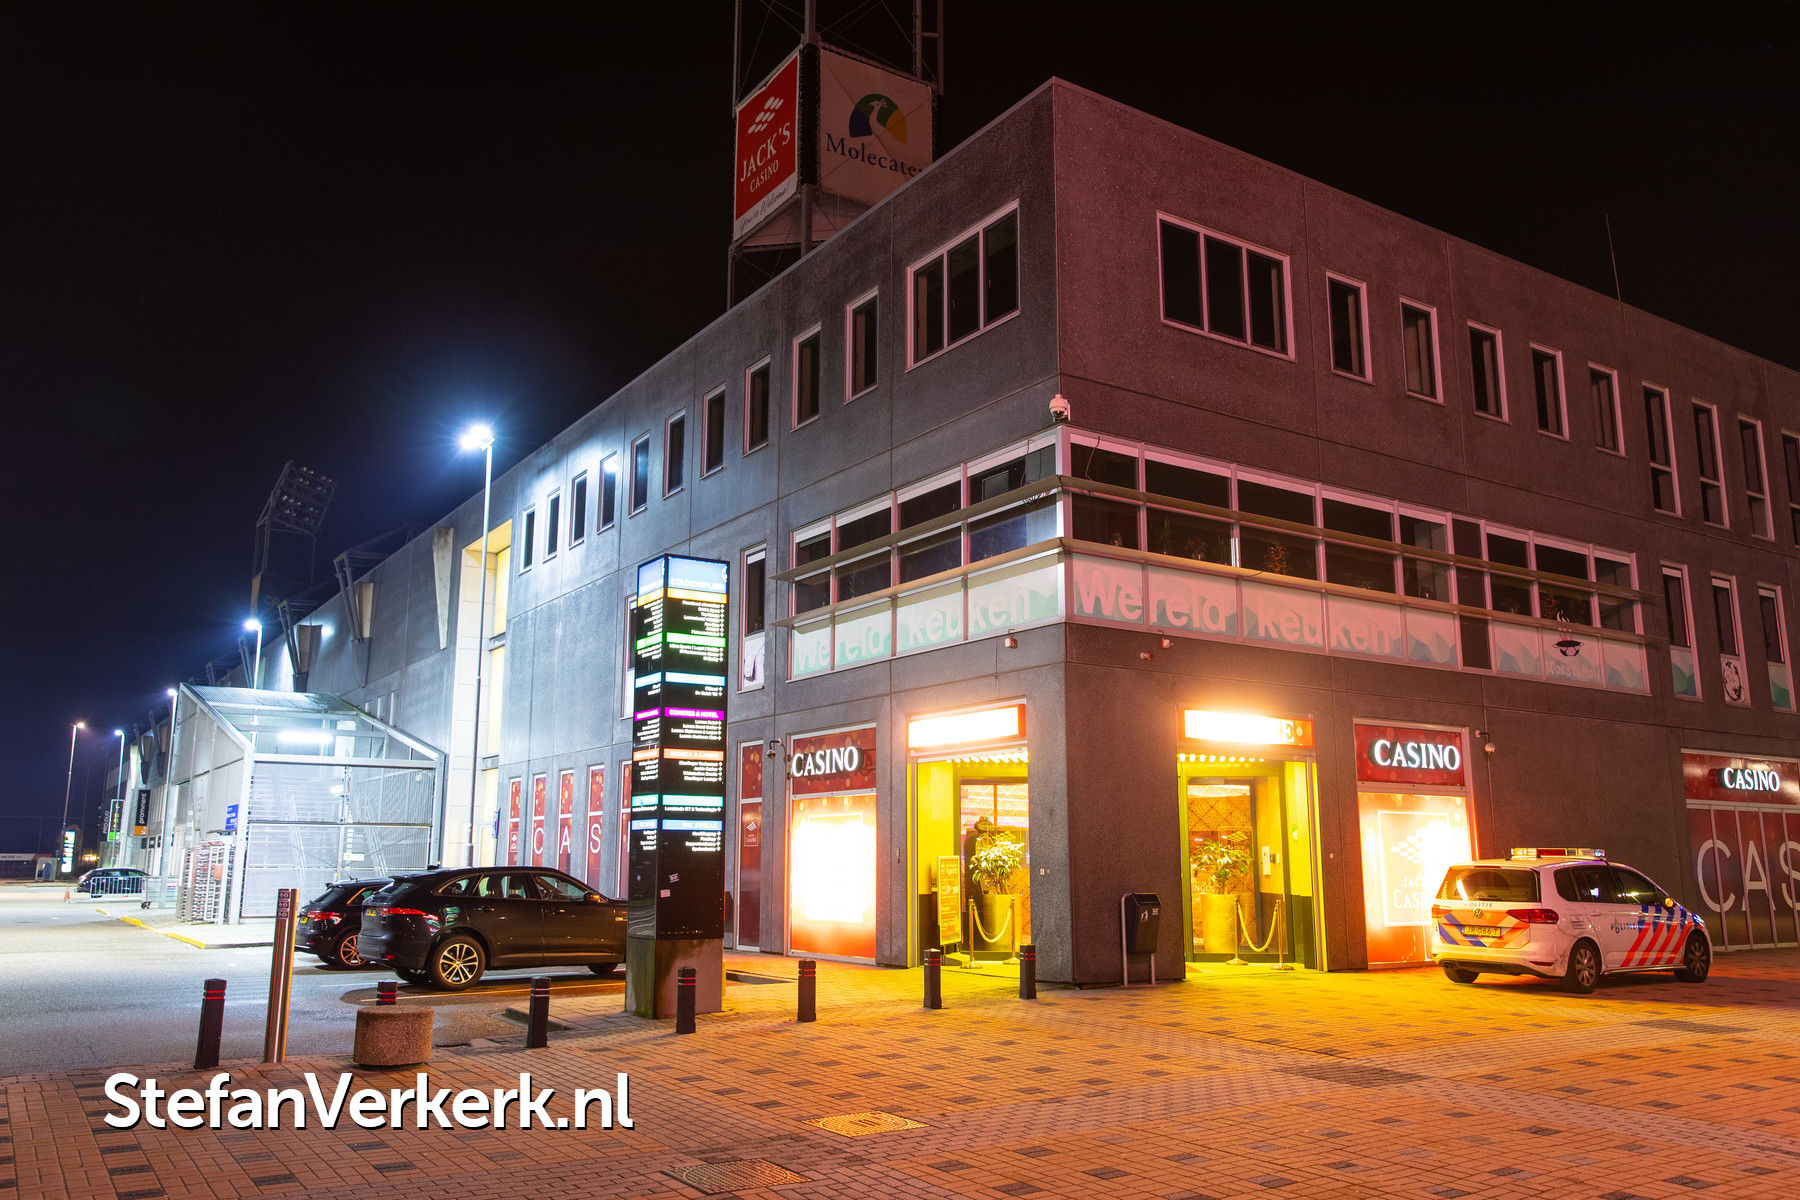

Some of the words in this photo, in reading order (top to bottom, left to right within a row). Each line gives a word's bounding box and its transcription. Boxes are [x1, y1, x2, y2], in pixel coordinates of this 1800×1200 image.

[740, 122, 791, 183] JACK'S
[750, 159, 779, 193] CASINO
[791, 745, 860, 777] CASINO
[1373, 738, 1461, 771] CASINO
[1723, 767, 1781, 792] CASINO
